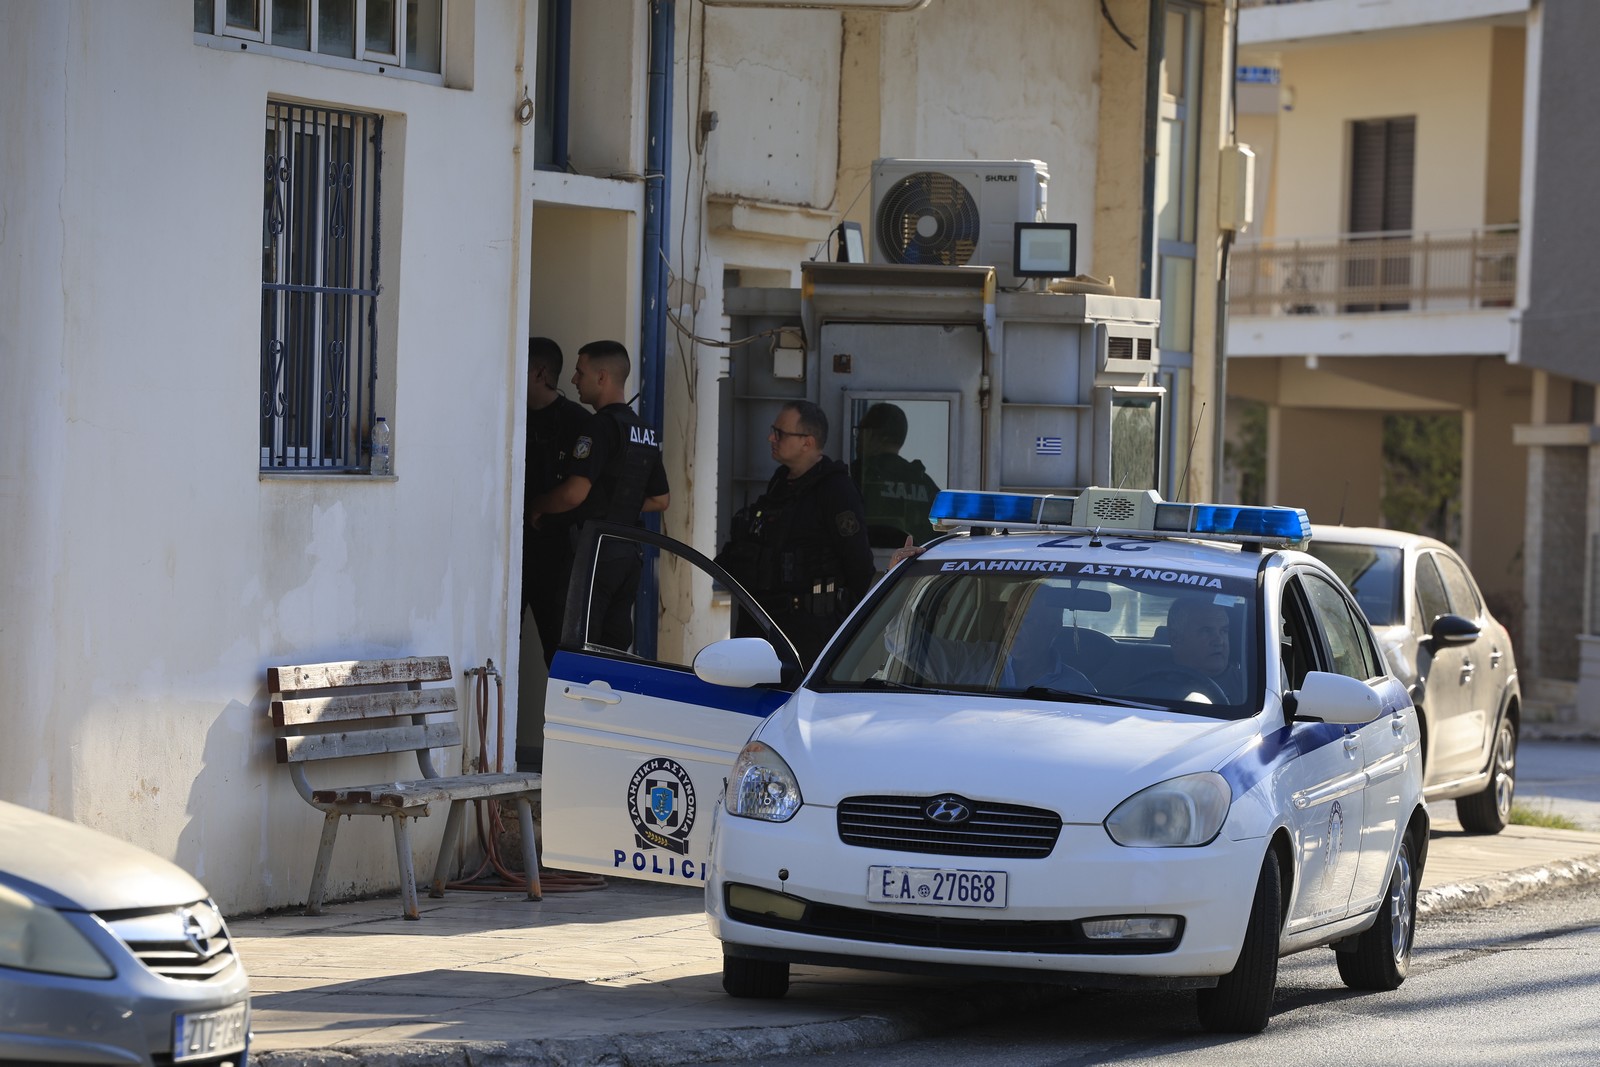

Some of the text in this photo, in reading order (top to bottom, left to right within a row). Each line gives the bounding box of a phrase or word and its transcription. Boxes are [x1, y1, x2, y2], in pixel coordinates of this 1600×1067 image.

[940, 560, 1223, 589] ΕΛΛΗΝΙΚΗ ΑΣΤΥΝΟΜΙΑ
[628, 760, 696, 834] ΕΛΛΗΝΙΚΗ ΑΣΤΥΝΟΜΙΑ
[932, 872, 996, 903] 27668
